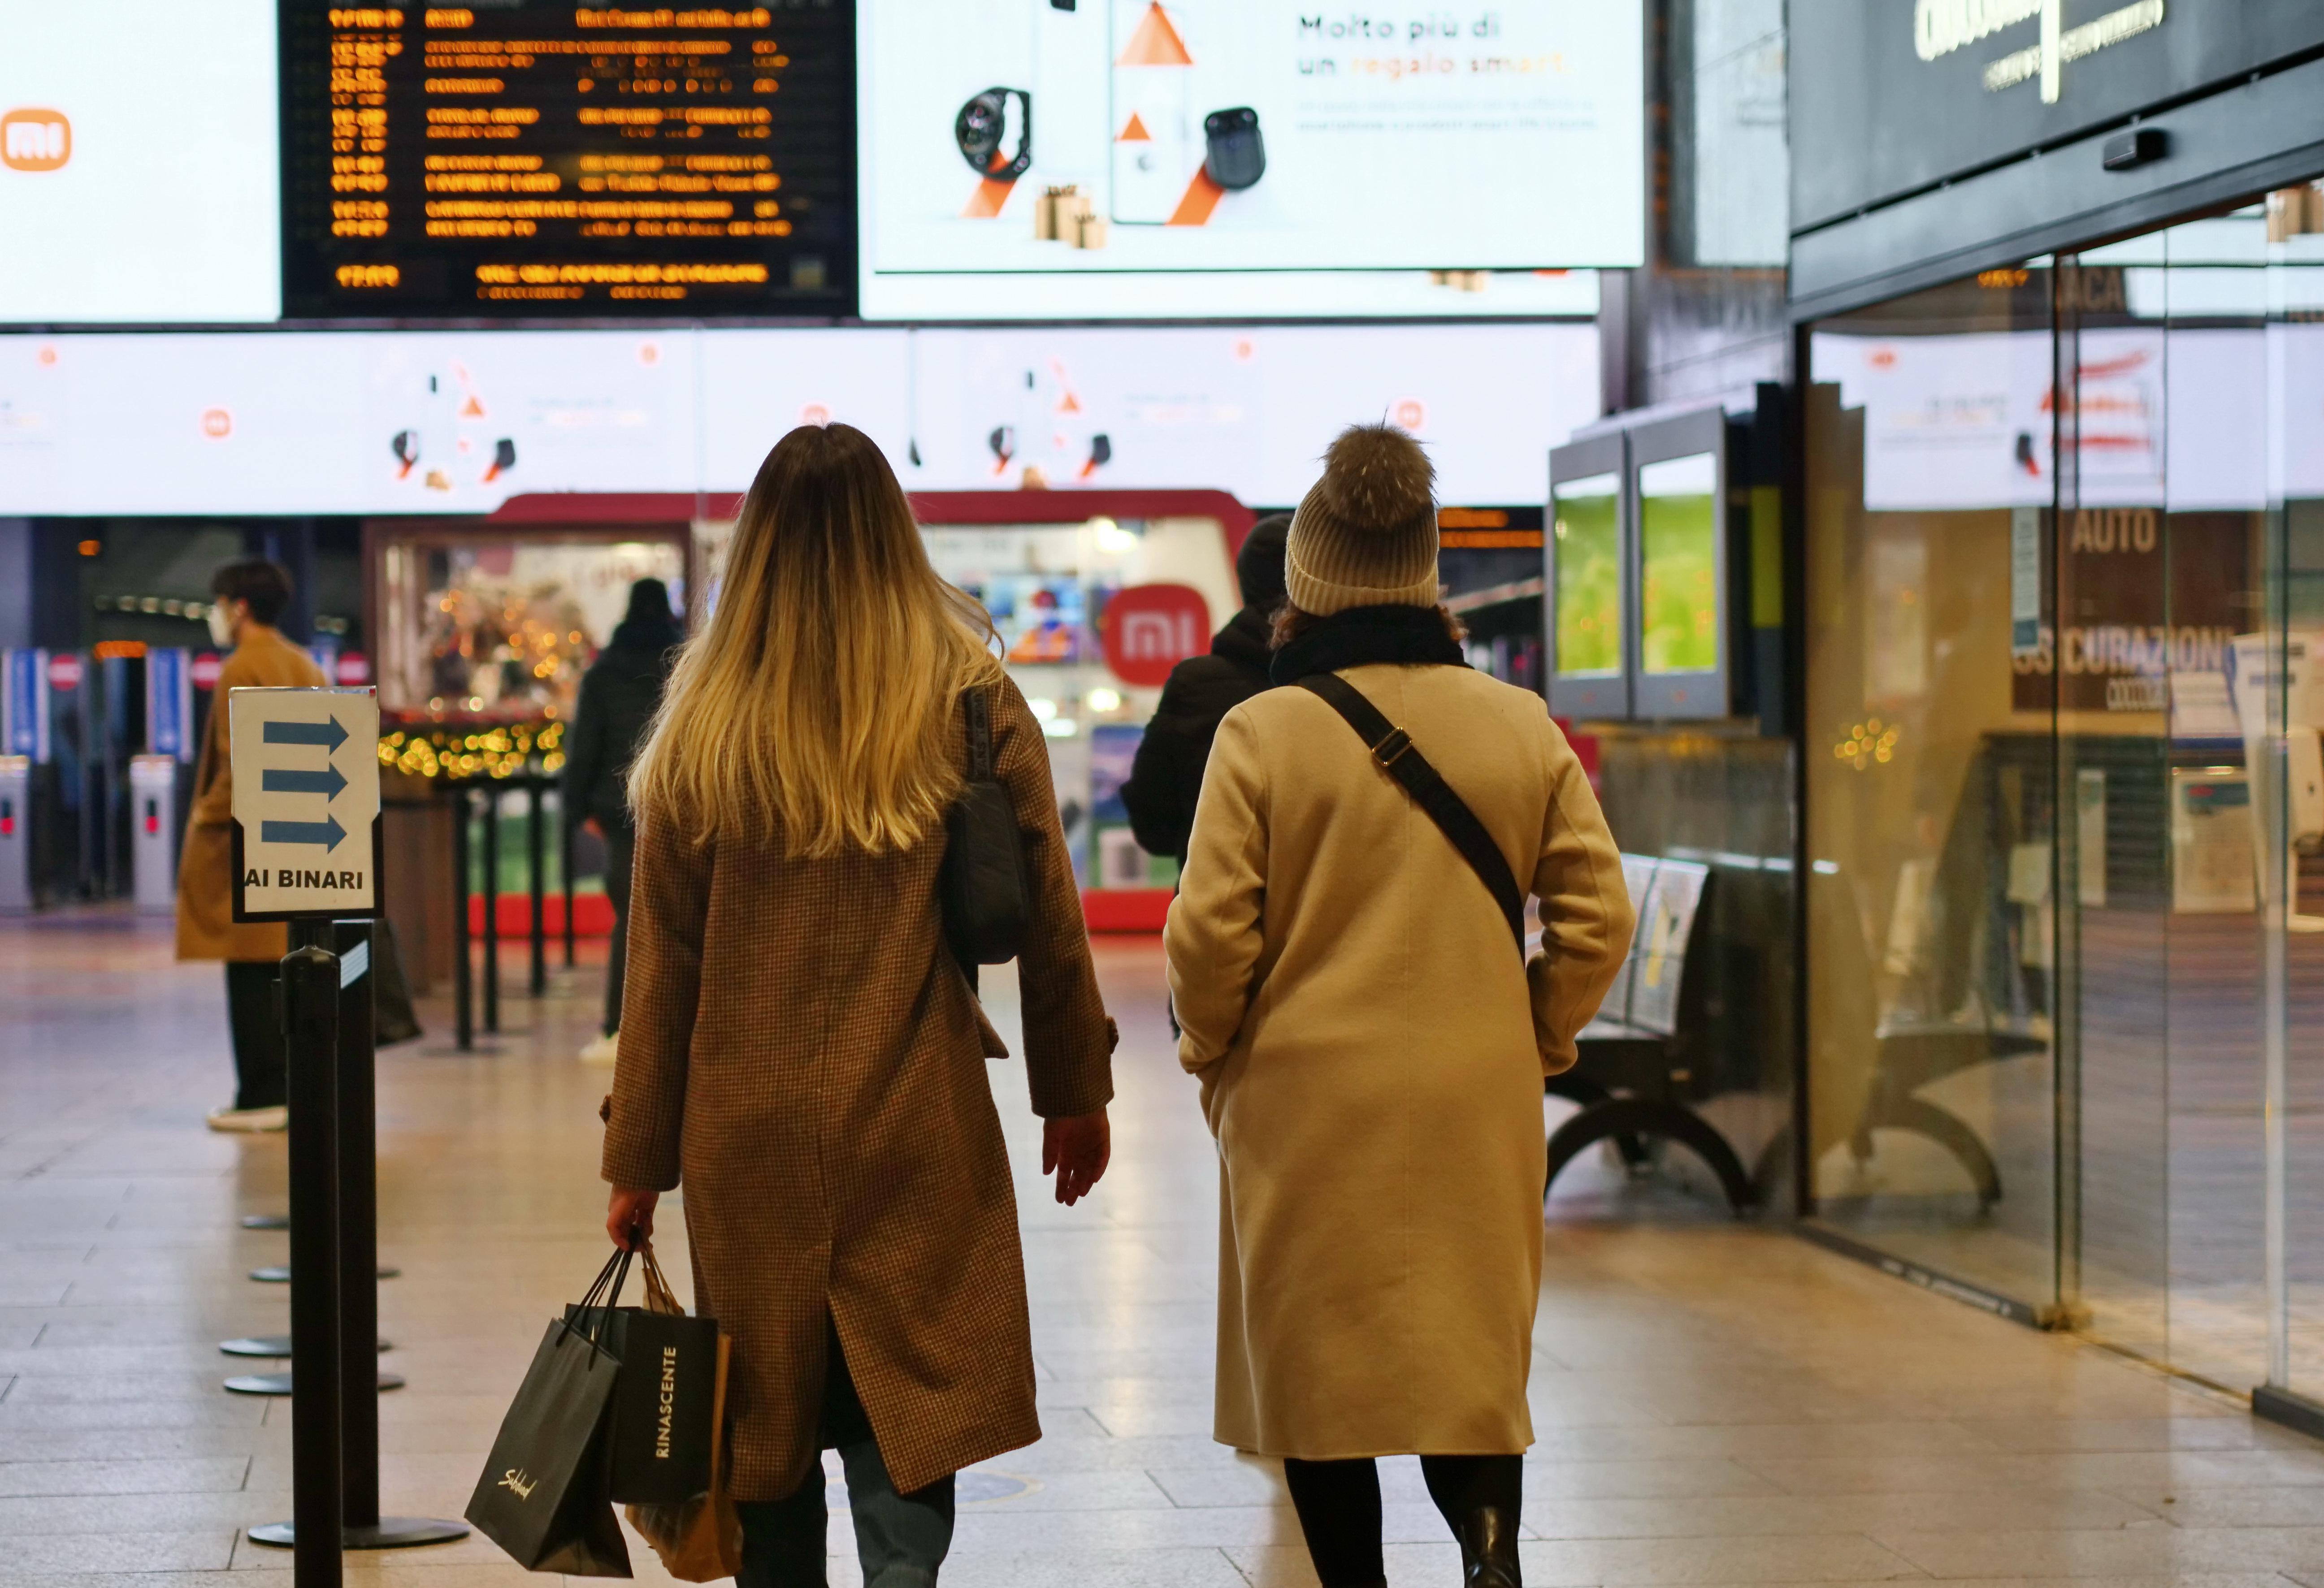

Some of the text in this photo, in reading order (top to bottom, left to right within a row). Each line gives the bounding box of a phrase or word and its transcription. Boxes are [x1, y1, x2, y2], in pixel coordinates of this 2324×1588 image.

[1299, 12, 1500, 43] Molto più di
[1299, 56, 1335, 74] un
[1350, 51, 1455, 79] regalo
[2070, 508, 2157, 553] AUTO
[244, 869, 362, 889] AI BINARI
[655, 1346, 676, 1458] RINASCENTE
